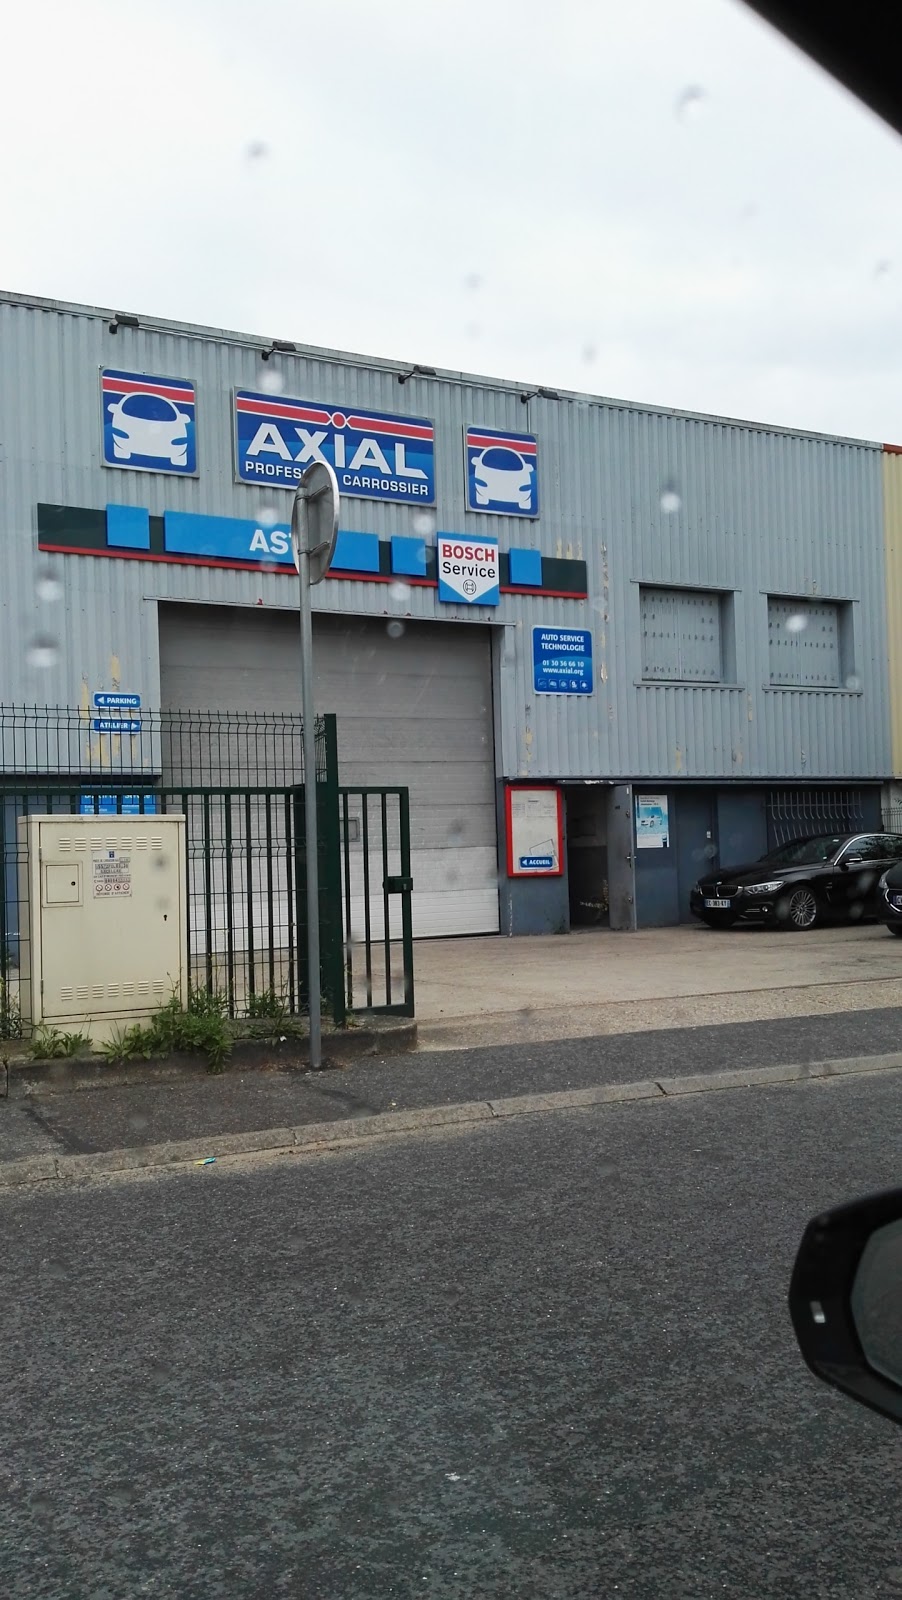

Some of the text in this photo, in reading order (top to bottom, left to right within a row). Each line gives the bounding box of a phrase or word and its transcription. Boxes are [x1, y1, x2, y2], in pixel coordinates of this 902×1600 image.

[246, 422, 428, 480] AXIAL
[343, 474, 429, 496] CARROSSIER
[249, 529, 292, 555] AS
[442, 544, 495, 562] BOSCH
[442, 561, 496, 578] Service
[541, 633, 584, 642] AUTO SERVICE
[541, 642, 584, 652] TECHNOLOGIE
[542, 667, 583, 676] www.axial.org
[106, 697, 137, 705] PARKING
